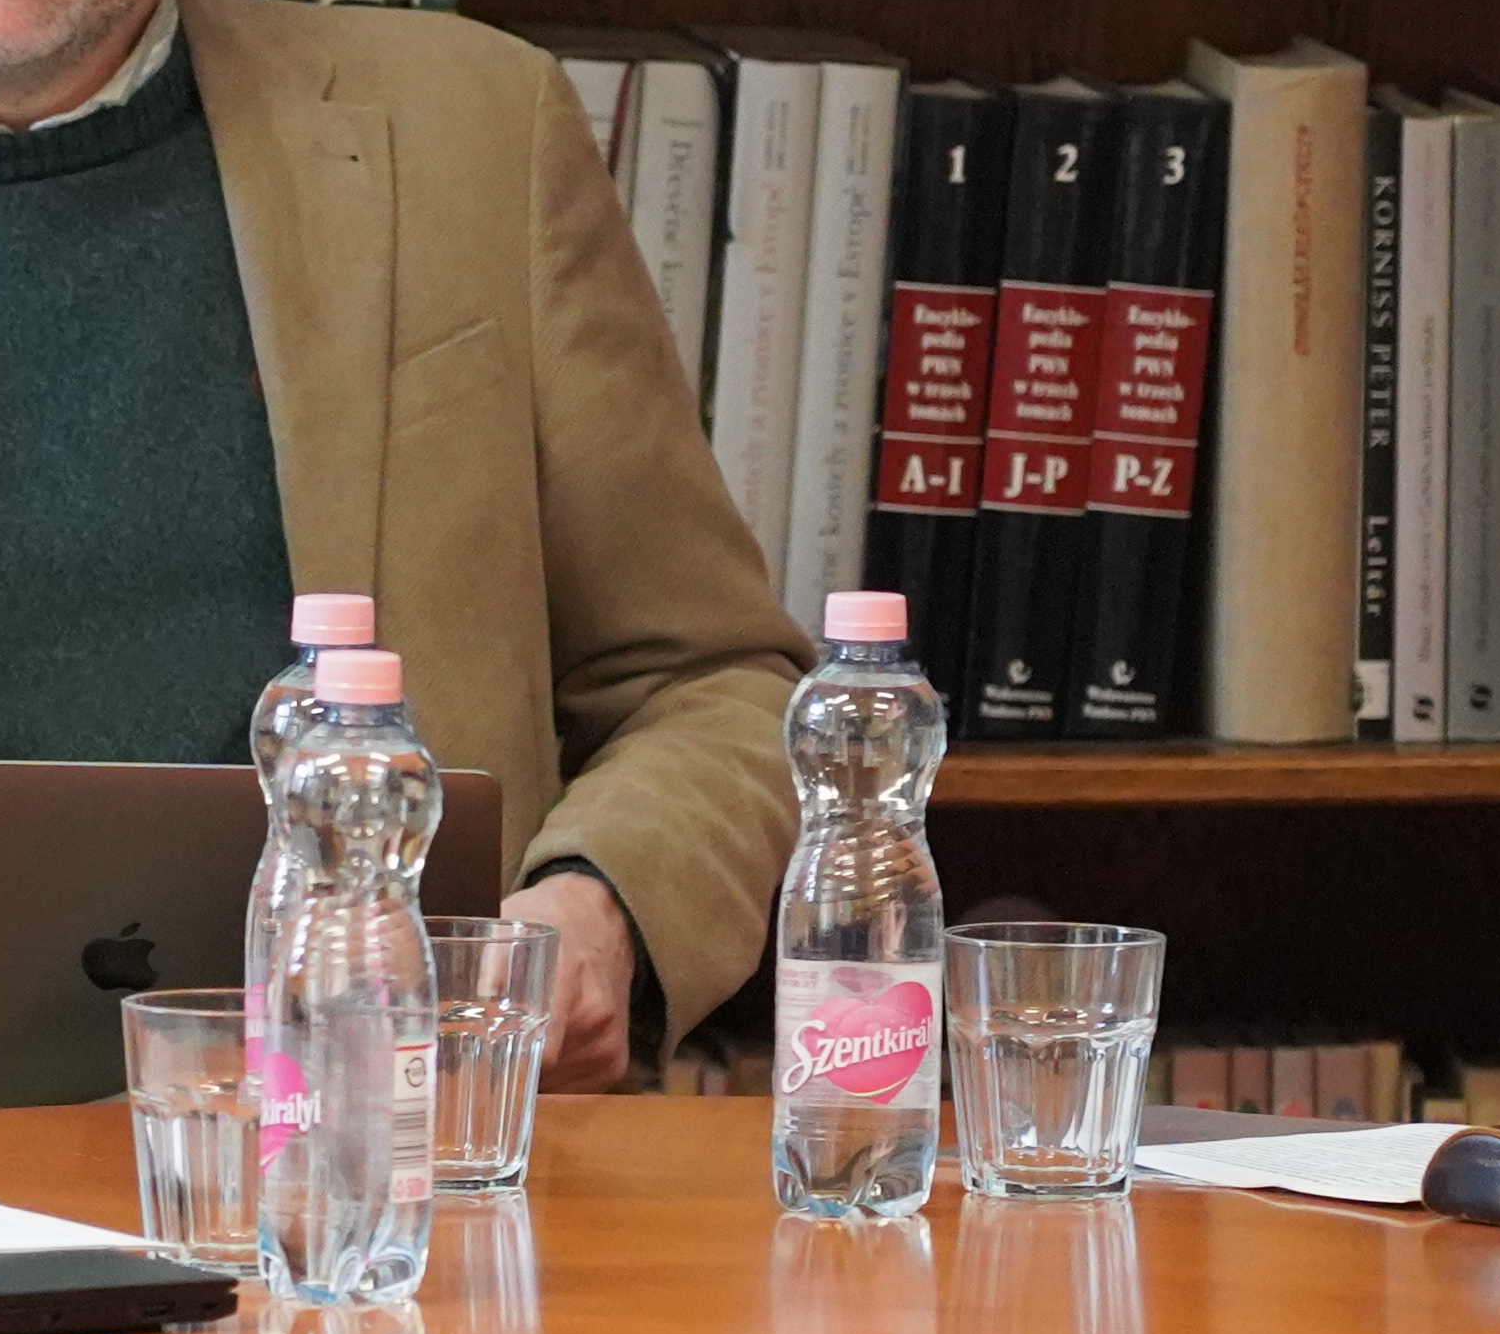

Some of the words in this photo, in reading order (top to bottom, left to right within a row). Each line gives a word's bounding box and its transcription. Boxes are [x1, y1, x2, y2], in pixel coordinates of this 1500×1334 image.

[947, 143, 967, 184] 1
[1053, 142, 1080, 184] 2
[1161, 145, 1187, 186] 3
[1370, 175, 1396, 329] KORNISS
[913, 302, 983, 329] Encyklo-
[1021, 301, 1091, 329] Encyklo-
[1126, 302, 1197, 330] Encyklo-
[920, 329, 966, 352] pedia
[1027, 329, 1074, 351] pedia
[1133, 330, 1180, 352] pedia
[920, 354, 963, 378] PWN
[1027, 352, 1070, 377] PWN
[1132, 354, 1176, 378] PWN
[905, 381, 920, 396] w
[923, 380, 973, 401] trzech
[1012, 380, 1028, 396] w
[1030, 379, 1081, 401] trzech
[1116, 381, 1134, 397] w
[1136, 381, 1185, 403] trzech
[908, 403, 967, 423] tomach
[1015, 403, 1073, 423] tomach
[1119, 404, 1179, 424] tomach
[898, 452, 966, 496] A-I
[1002, 452, 1069, 499] J-P
[1112, 453, 1175, 497] P-Z
[1366, 514, 1391, 620] Leltár
[781, 1014, 934, 1095] Szentkirál
